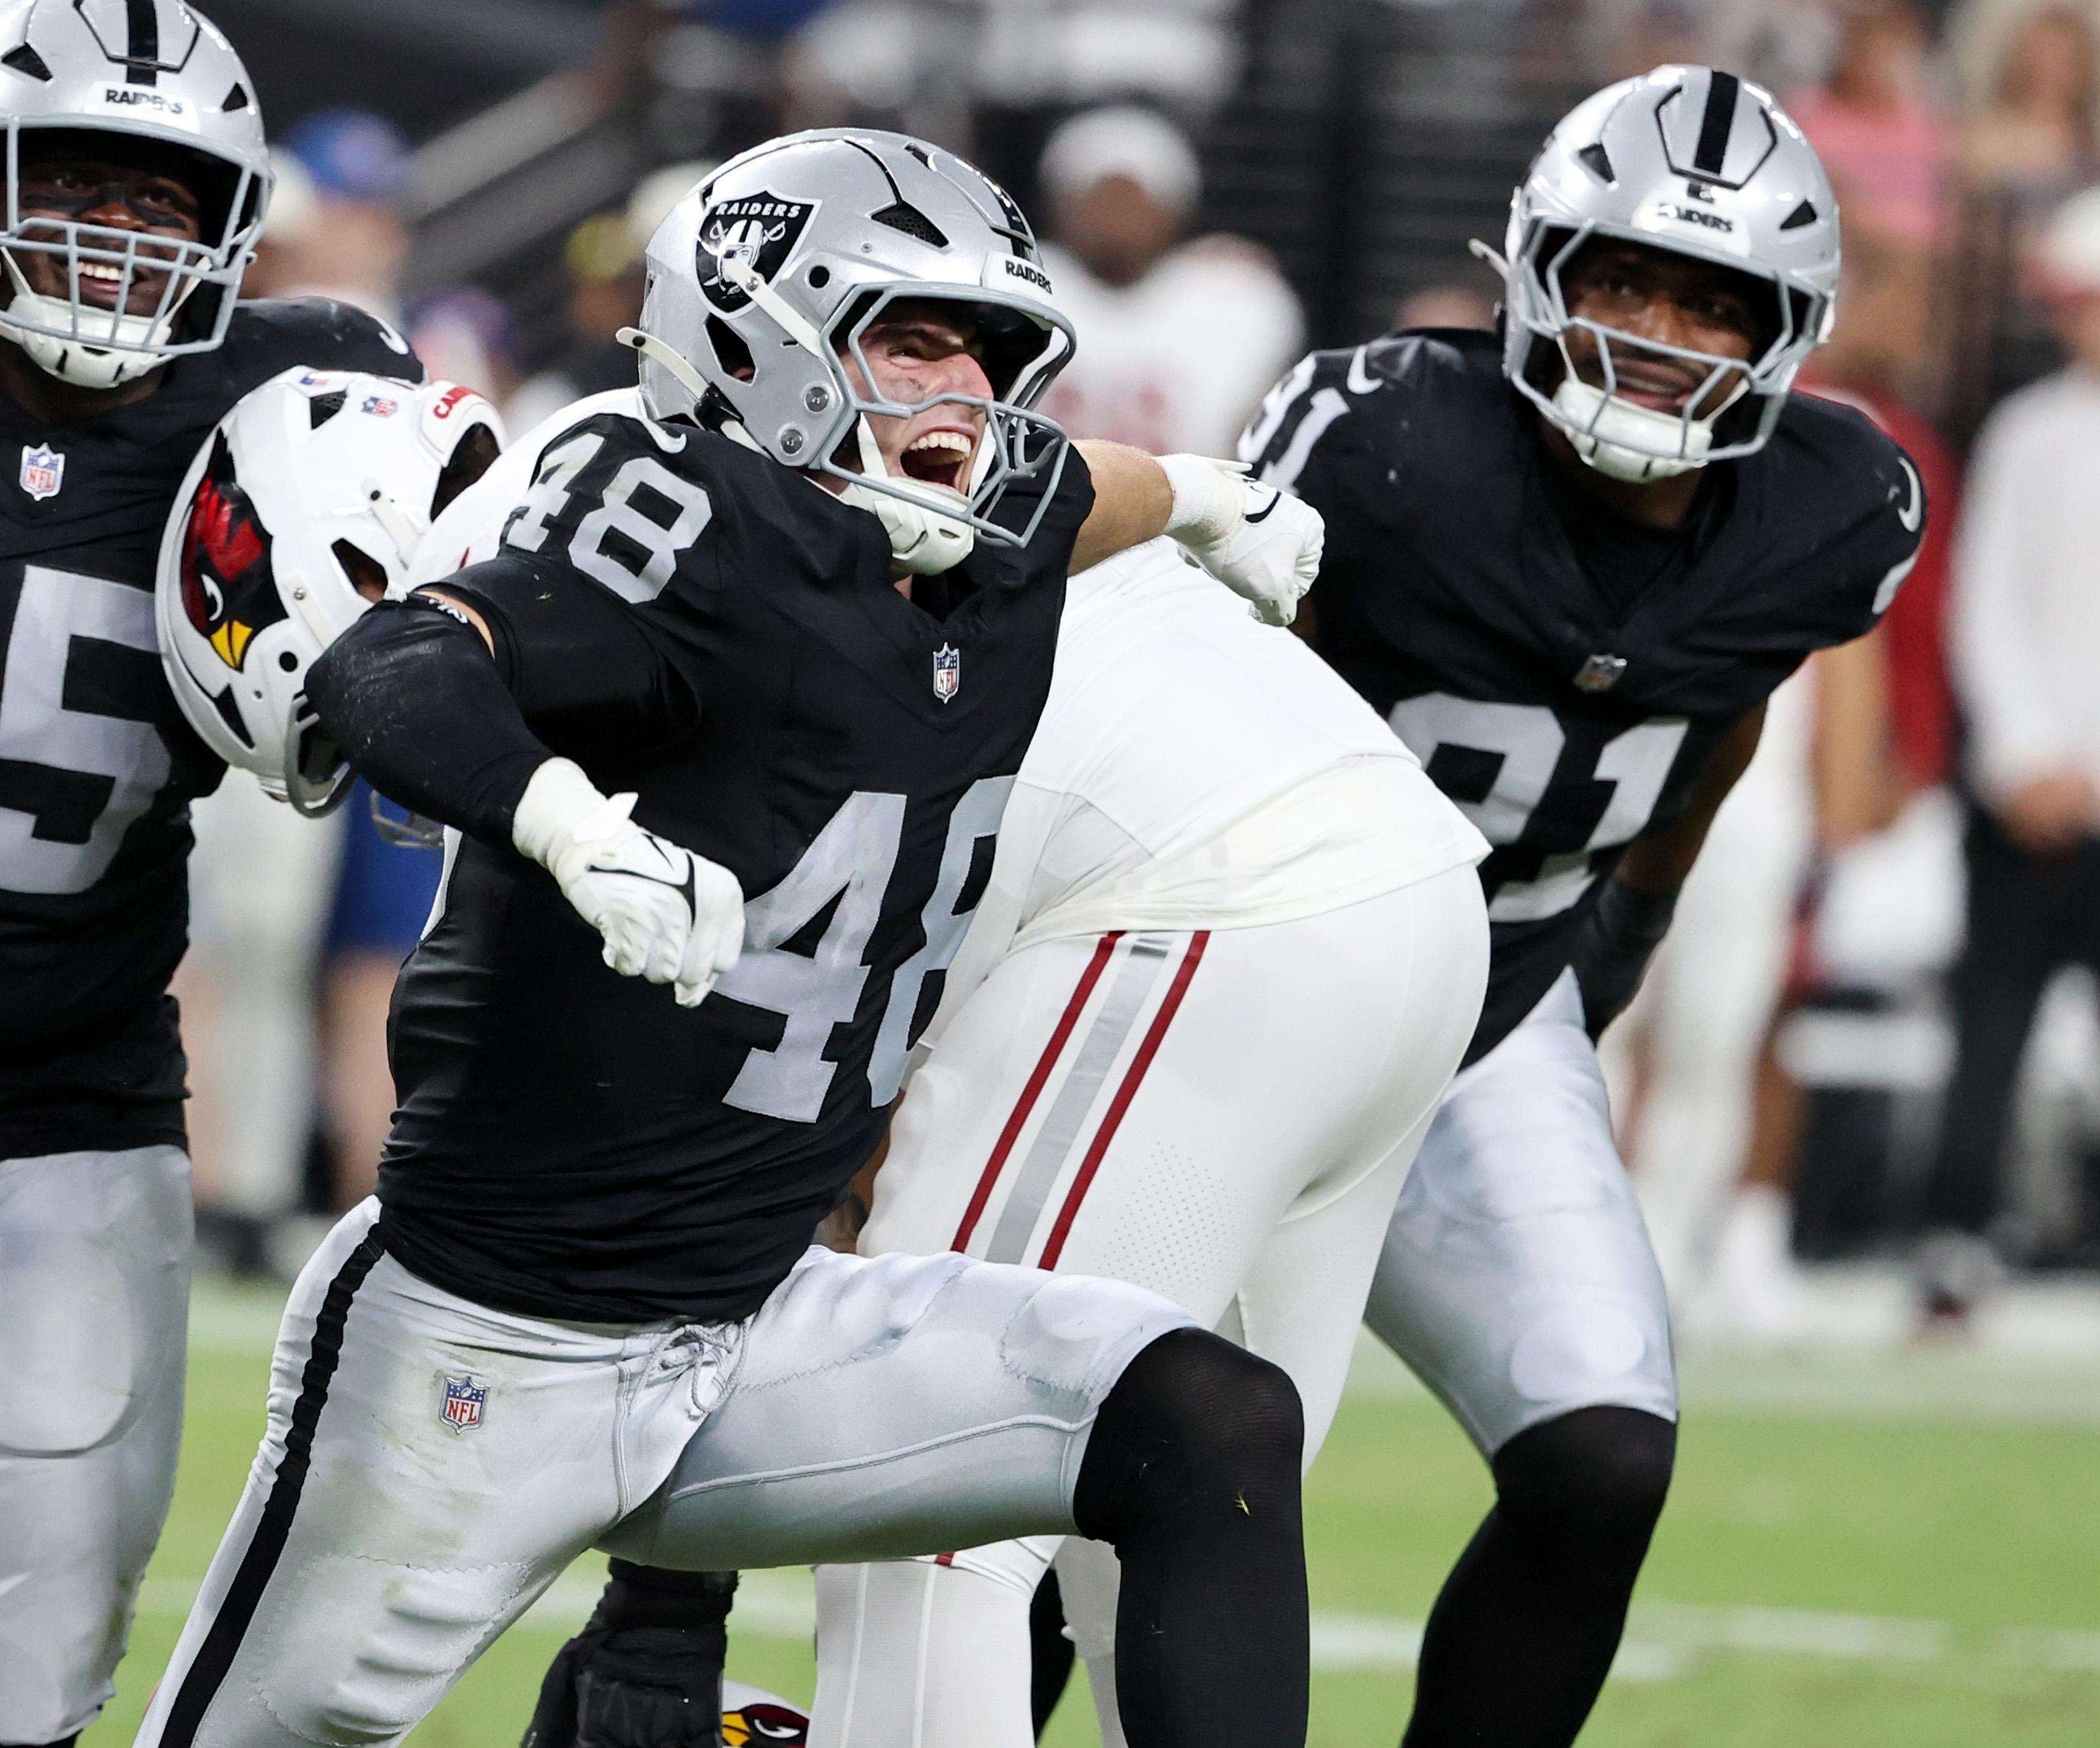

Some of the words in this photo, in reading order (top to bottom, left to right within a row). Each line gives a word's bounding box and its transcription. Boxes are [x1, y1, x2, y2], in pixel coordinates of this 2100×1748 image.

[715, 202, 801, 218] RAIDERS
[26, 468, 56, 489] NFL
[506, 432, 713, 604] 48
[937, 671, 957, 692] NFL
[713, 775, 1017, 1124] 48
[446, 1399, 477, 1423] NFL
